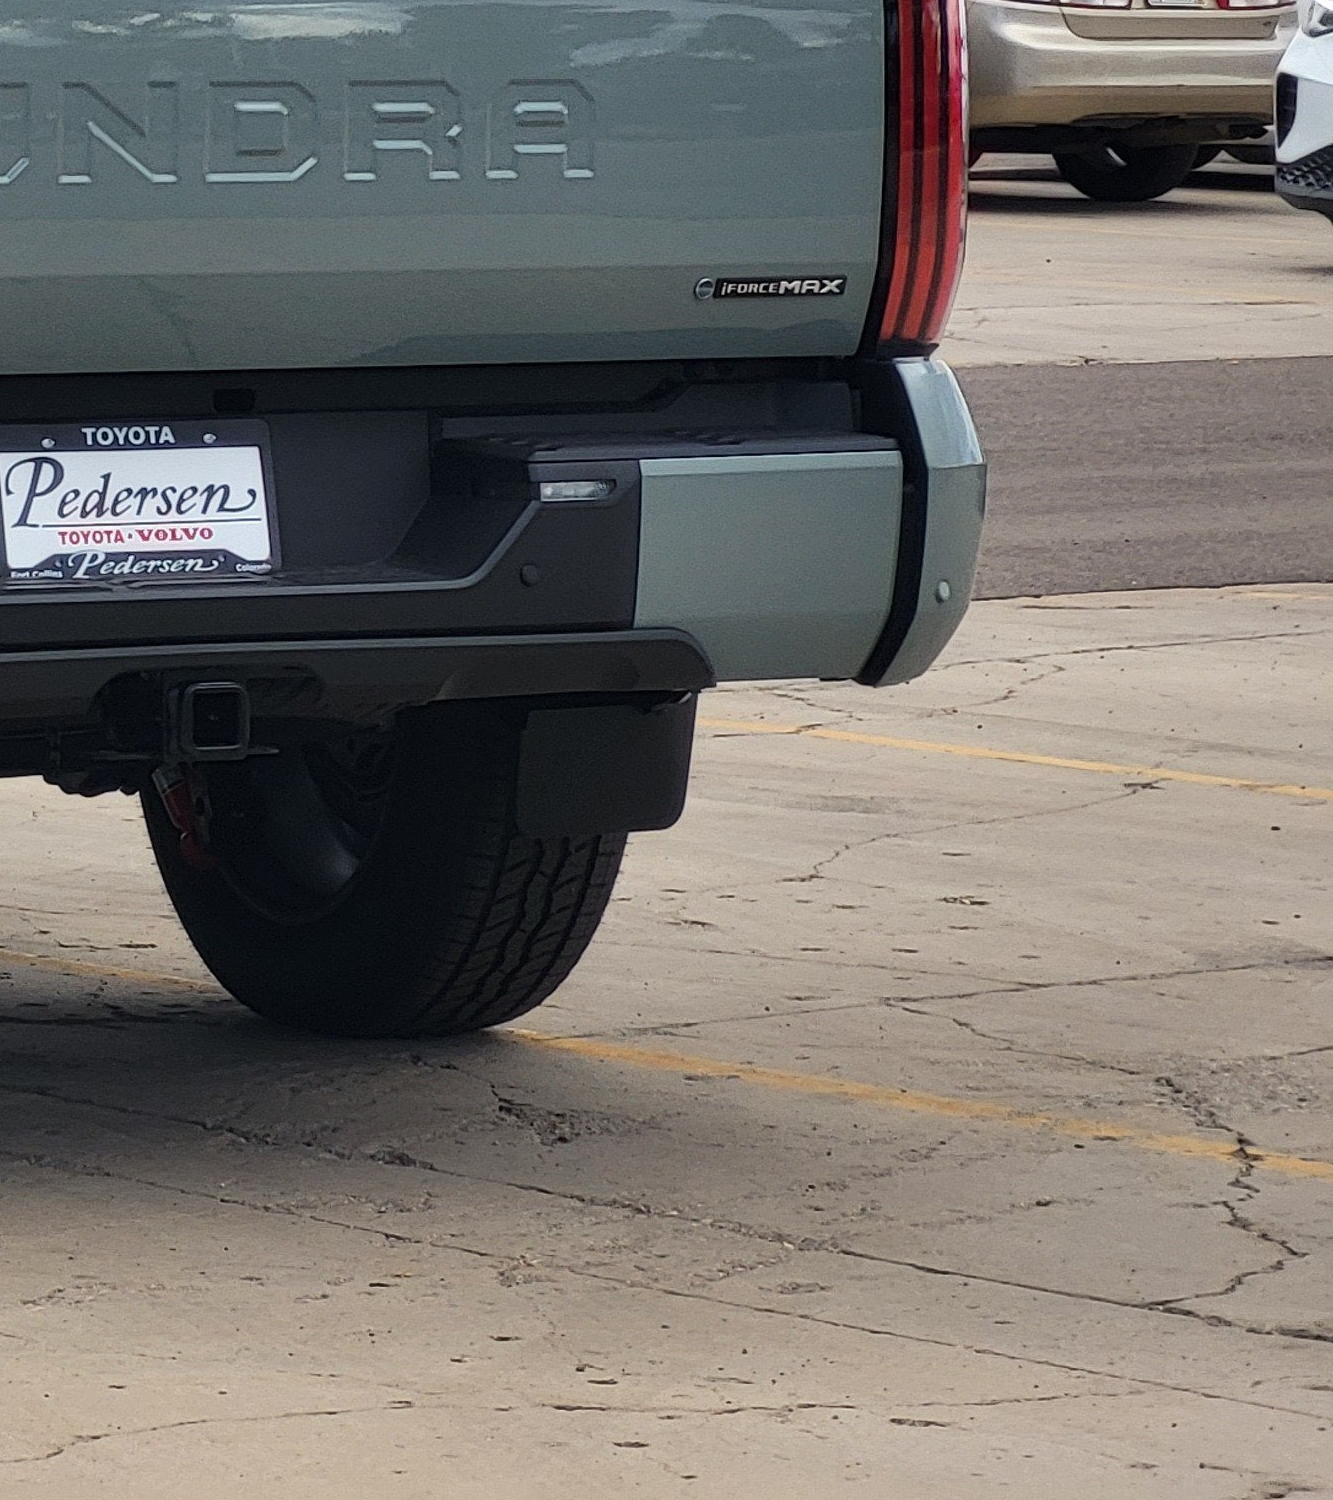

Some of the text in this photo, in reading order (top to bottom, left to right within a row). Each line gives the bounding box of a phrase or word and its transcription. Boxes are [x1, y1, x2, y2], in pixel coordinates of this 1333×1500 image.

[81, 425, 176, 447] TOYOTA
[5, 456, 257, 528] Pedersen
[58, 527, 214, 546] TOYOTA VOLVO
[67, 551, 224, 580] Pedersen
